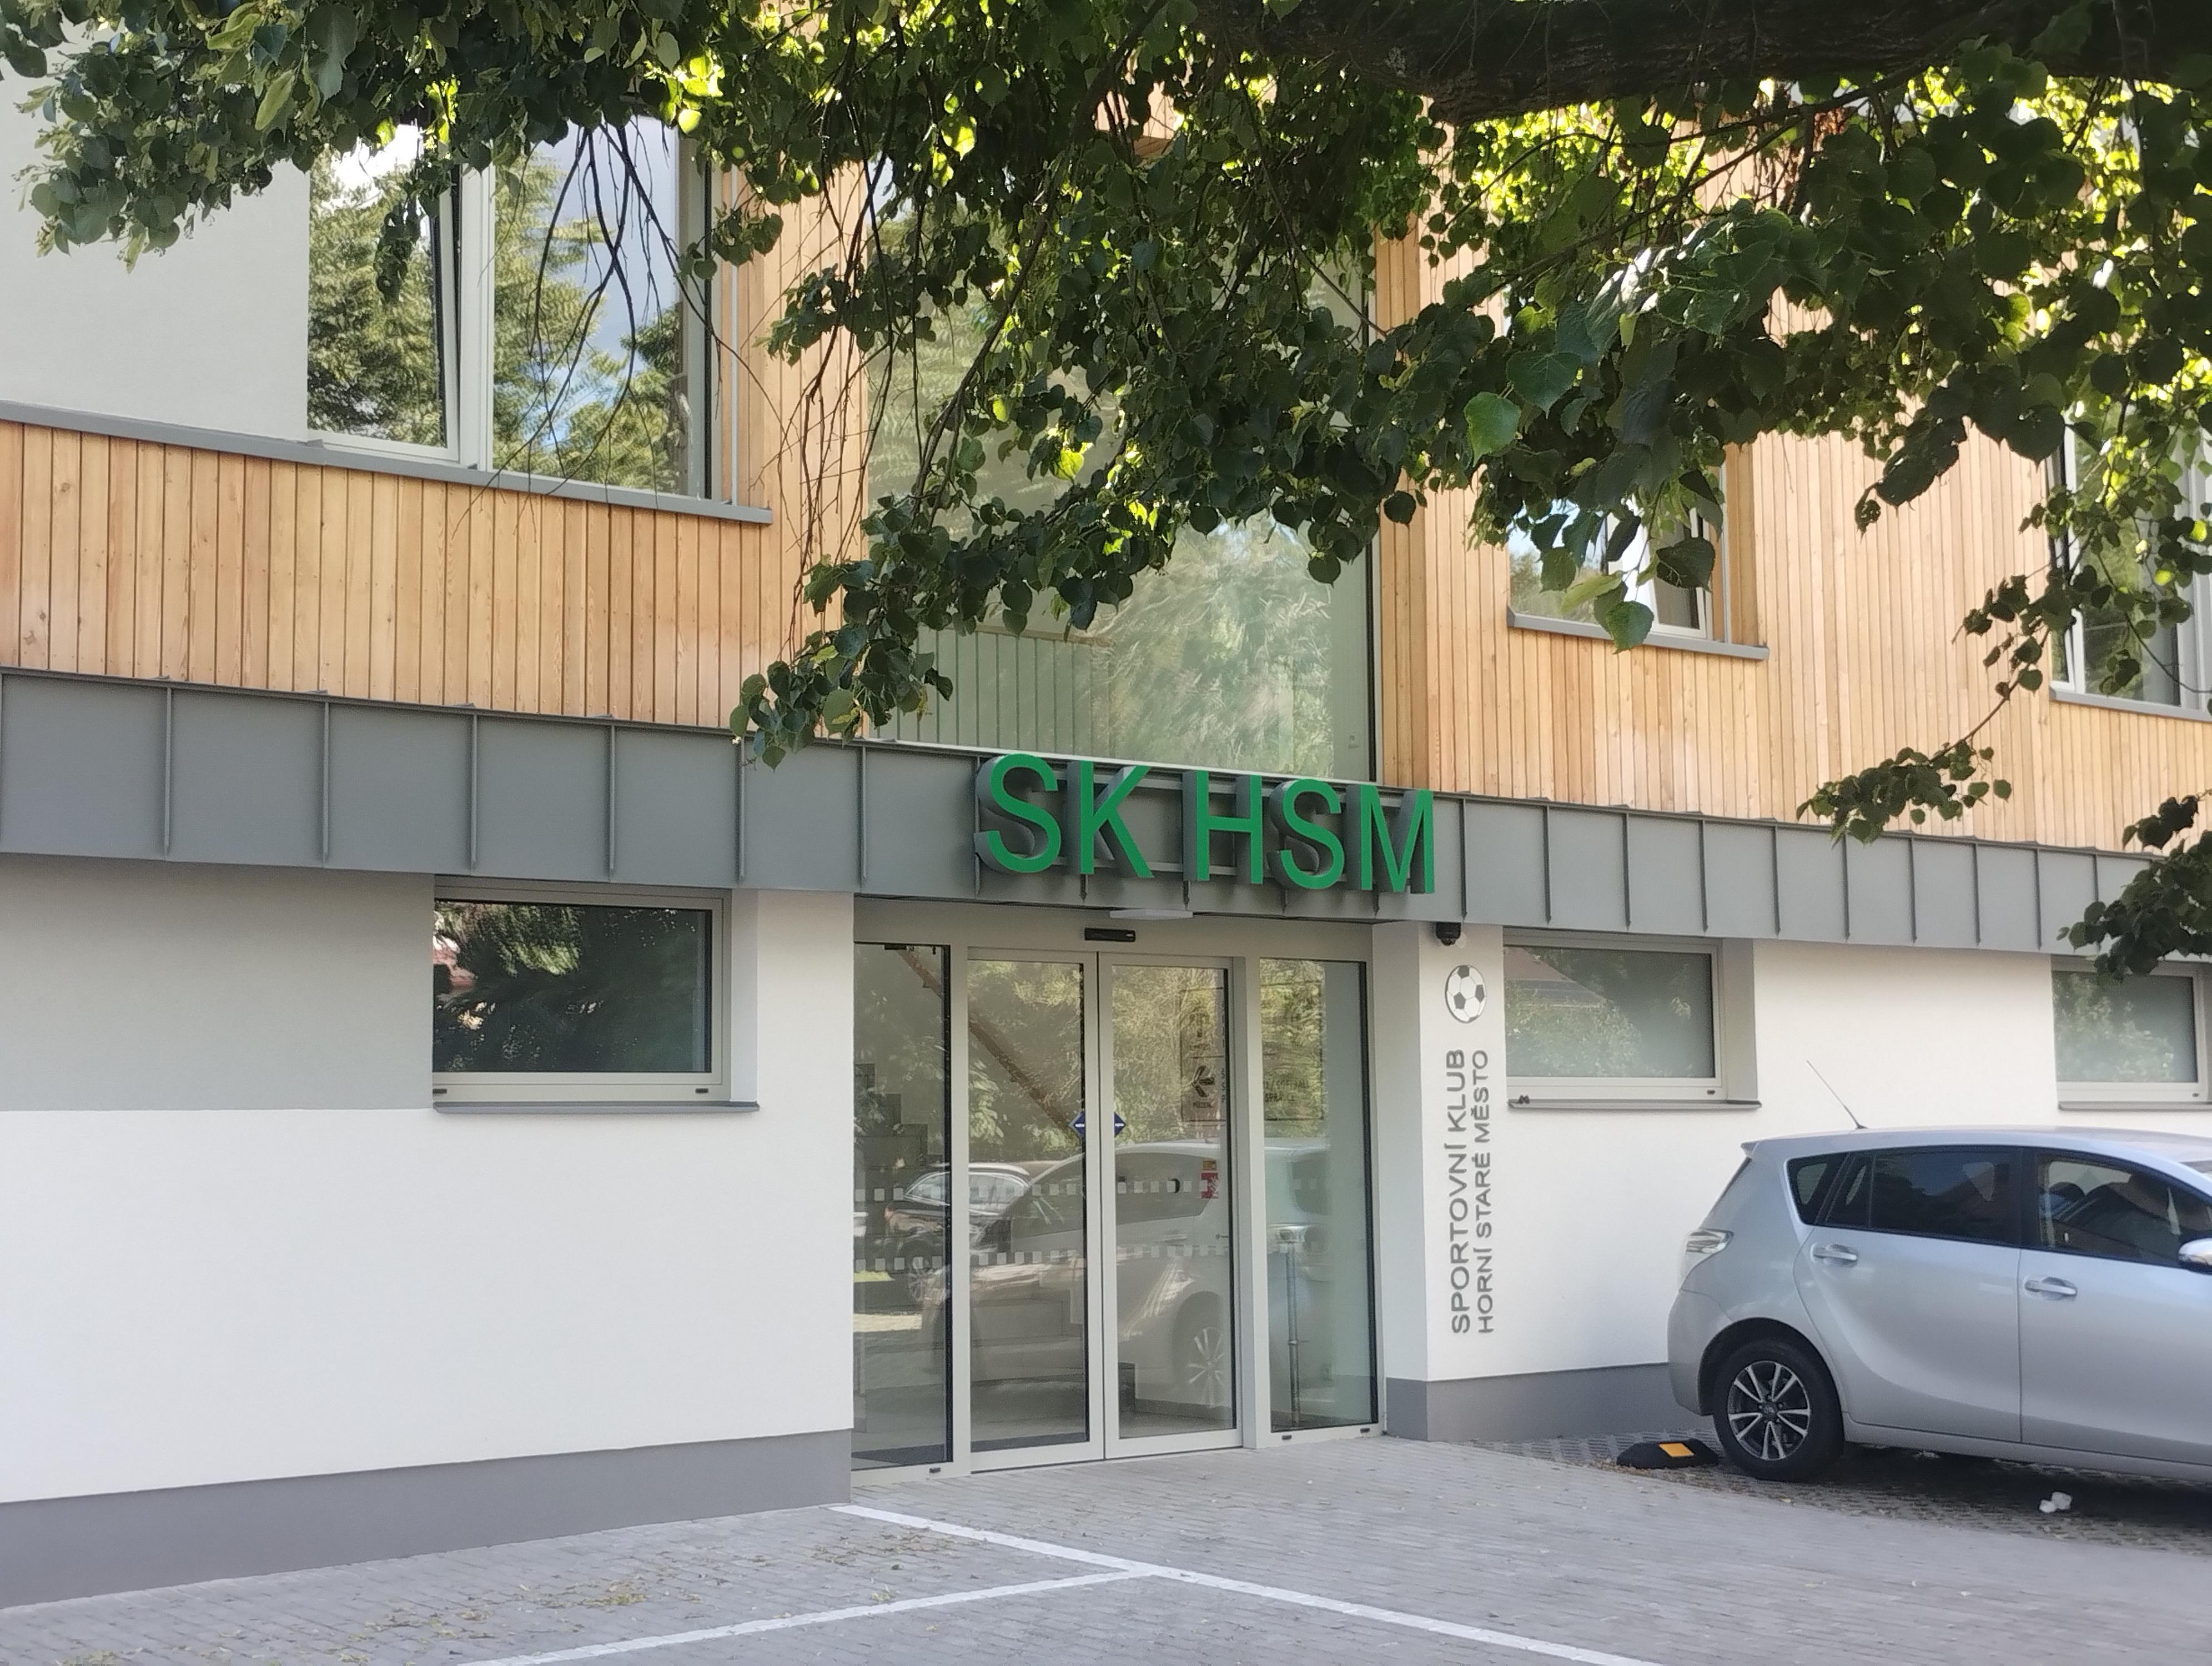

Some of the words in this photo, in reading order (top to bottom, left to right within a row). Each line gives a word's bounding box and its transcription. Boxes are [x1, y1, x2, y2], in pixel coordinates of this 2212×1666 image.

[986, 752, 1154, 879] SK
[1194, 770, 1435, 894] HSM
[1446, 1049, 1467, 1133] KLUB
[1471, 1050, 1491, 1144] MĚSTO
[1444, 1143, 1471, 1334] SPORTOVNÍ
[1471, 1152, 1493, 1240] STARÉ
[1473, 1248, 1495, 1334] HORNÍ
